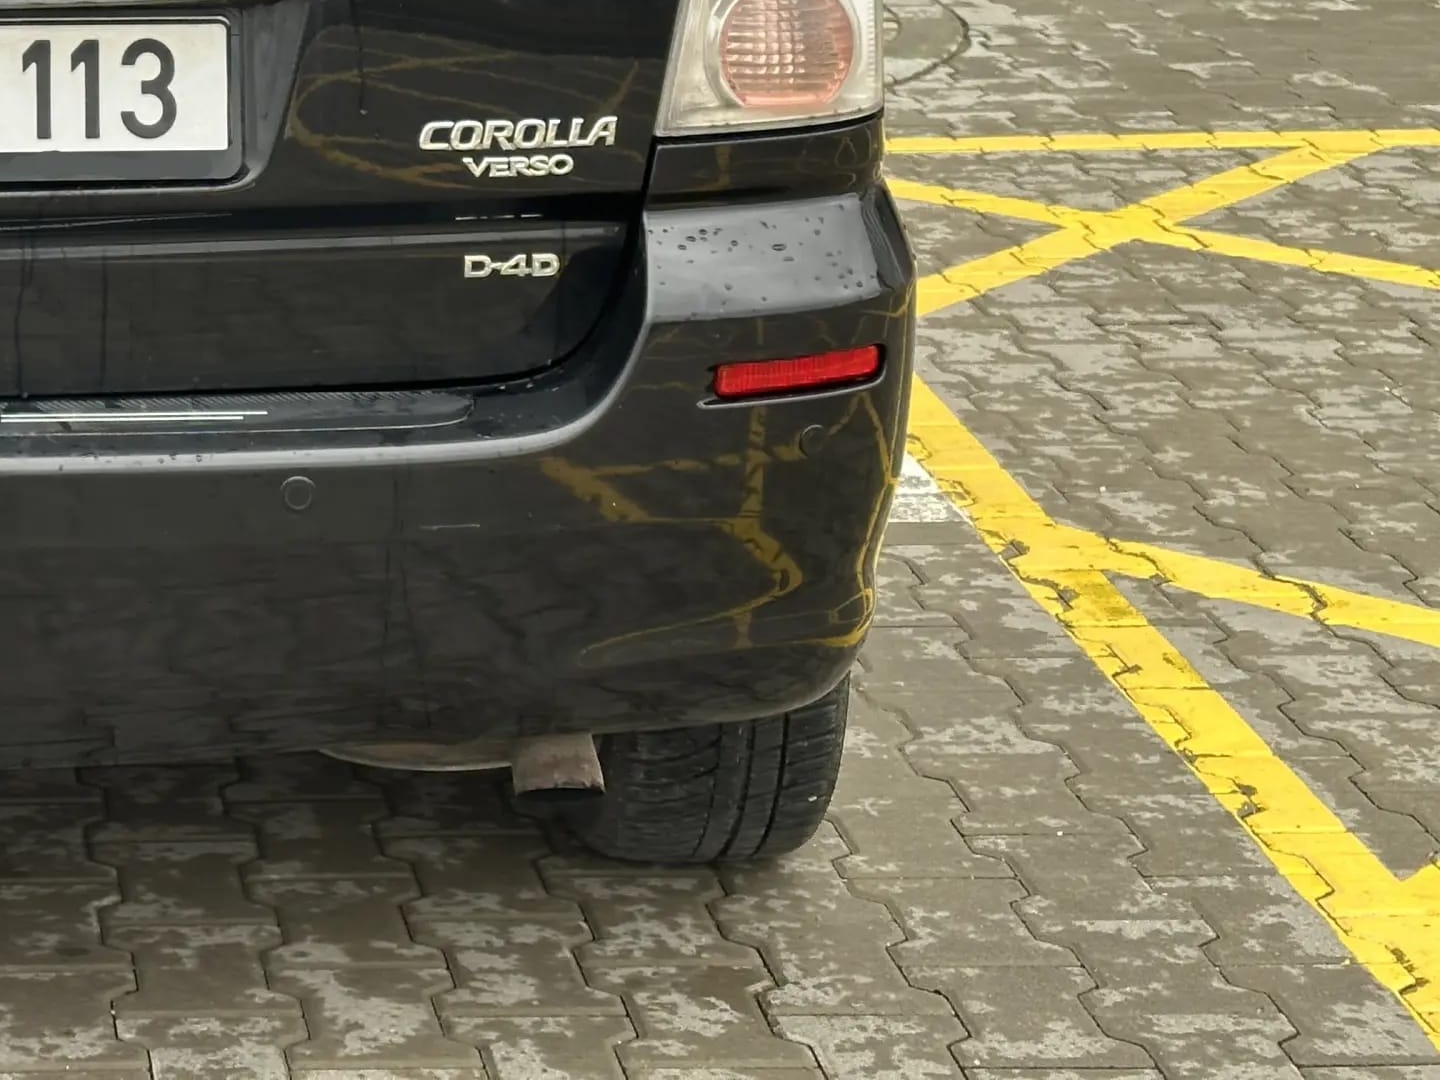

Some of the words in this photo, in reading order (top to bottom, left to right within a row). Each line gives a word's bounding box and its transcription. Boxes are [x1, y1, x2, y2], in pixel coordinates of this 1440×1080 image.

[419, 116, 618, 150] COROLLA
[462, 154, 574, 178] VERSO
[464, 253, 560, 278] D-4D
